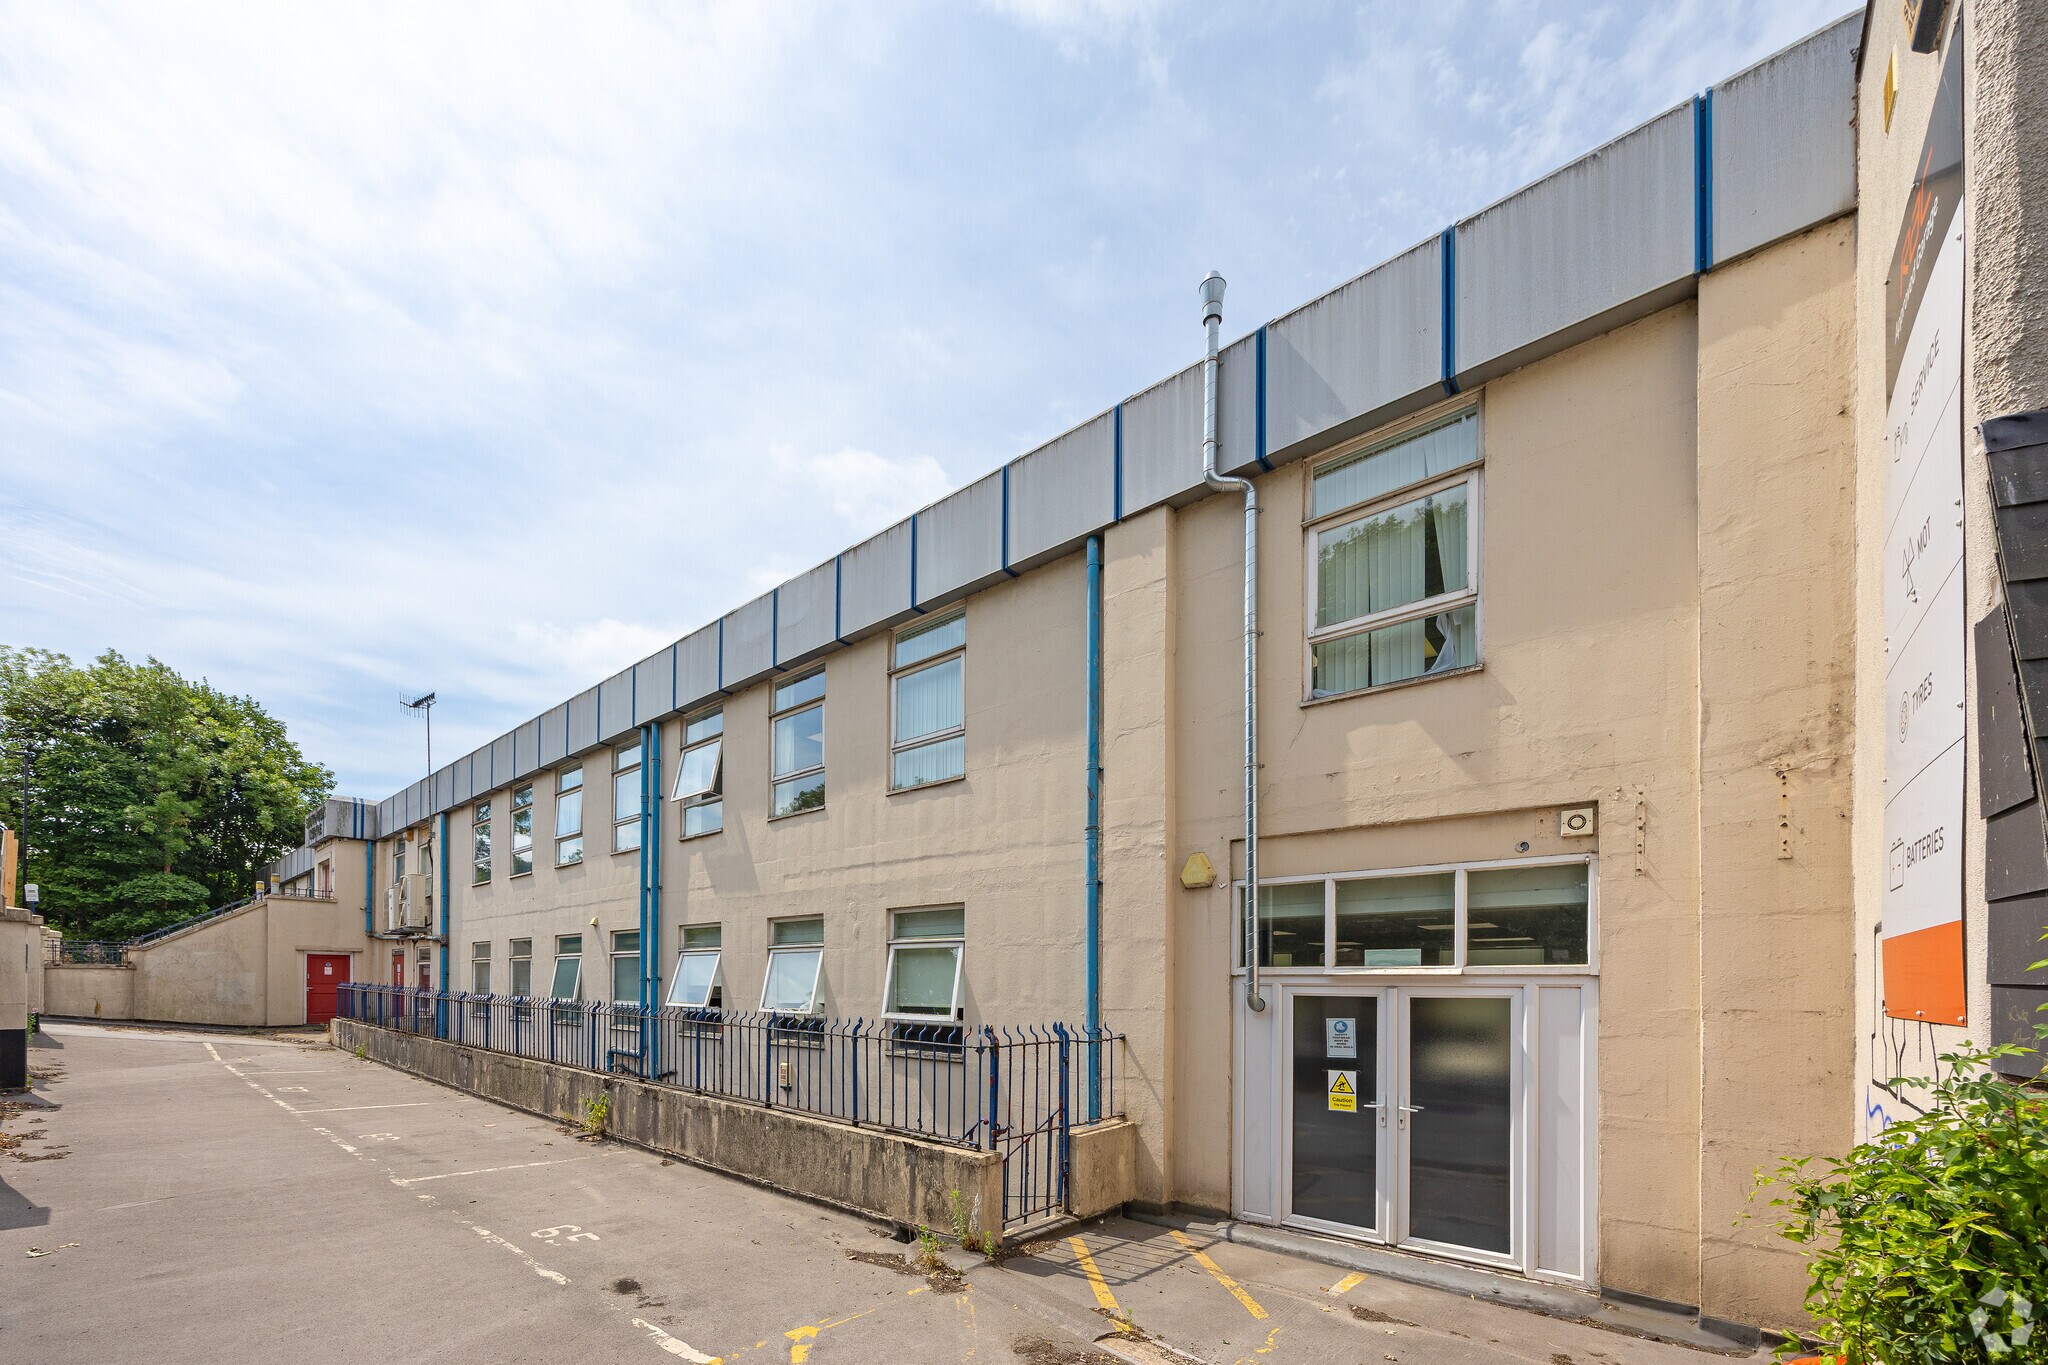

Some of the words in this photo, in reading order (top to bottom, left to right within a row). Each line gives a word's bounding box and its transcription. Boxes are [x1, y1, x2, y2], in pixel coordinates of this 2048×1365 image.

[1916, 196, 1938, 270] Garage
[1911, 328, 1940, 416] SERVICE
[1917, 515, 1931, 560] MOT
[1912, 671, 1933, 715] TYRES
[1906, 826, 1944, 868] BATTERIES
